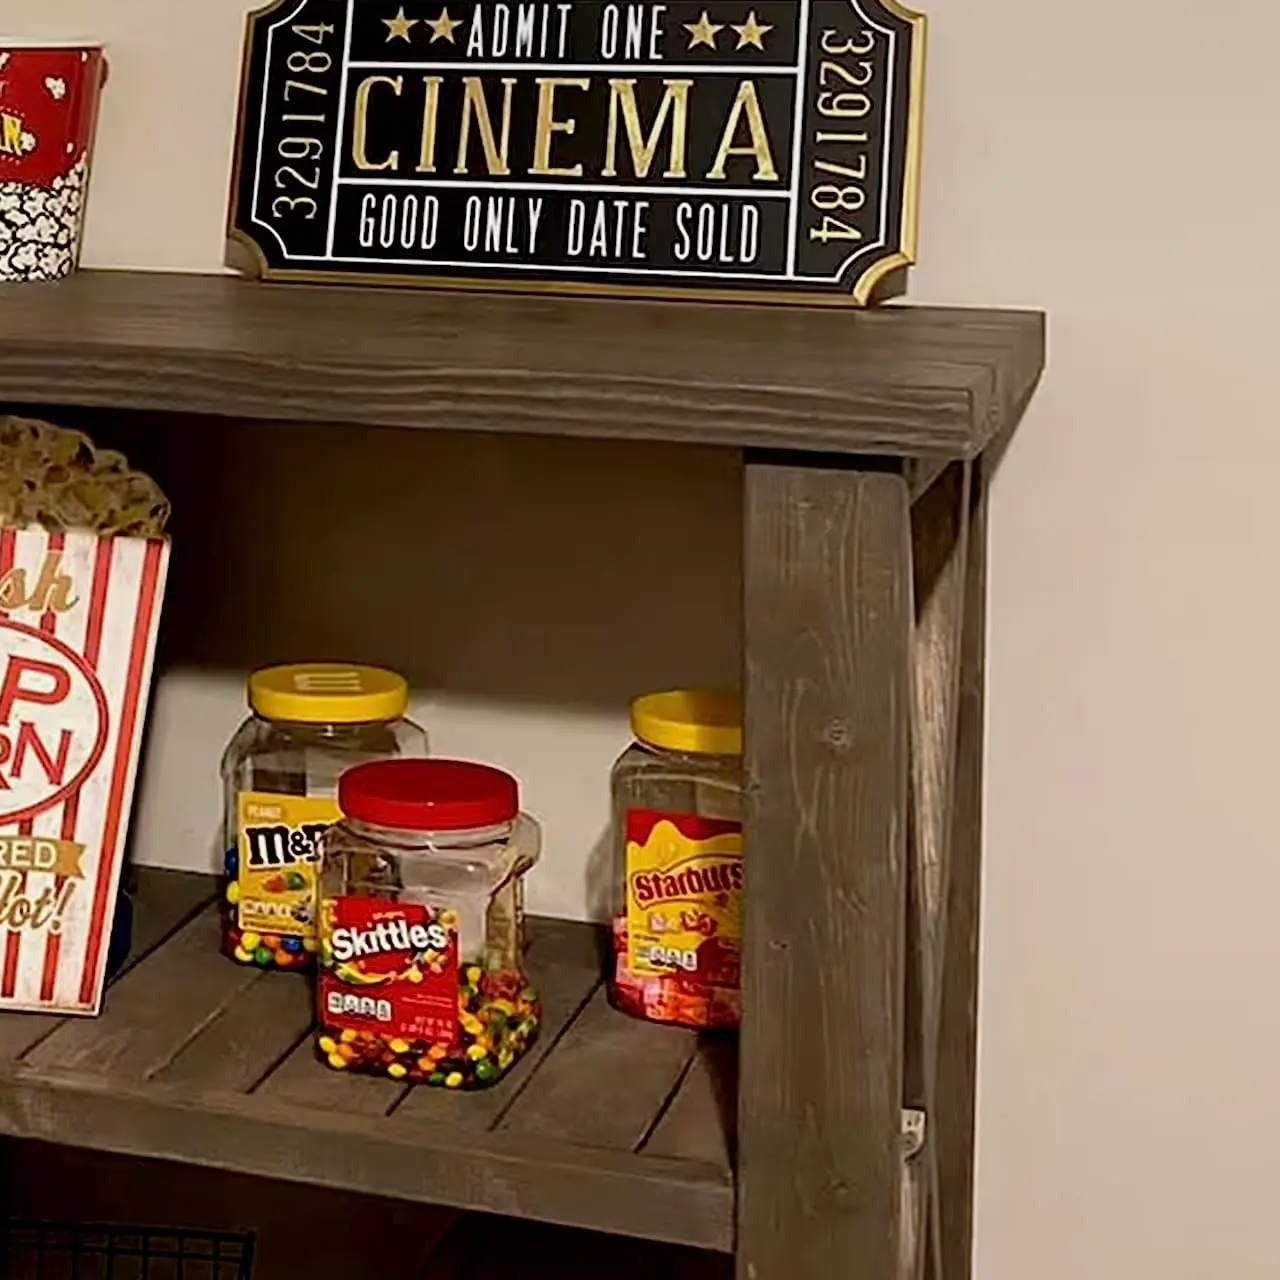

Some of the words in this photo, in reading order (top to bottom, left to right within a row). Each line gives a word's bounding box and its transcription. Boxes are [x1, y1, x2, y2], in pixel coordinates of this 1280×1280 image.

[466, 3, 573, 59] ADMIT
[600, 5, 667, 61] ONE
[272, 21, 335, 220] 3291784
[352, 75, 780, 183] CINEMA
[810, 29, 875, 245] 3291784
[359, 193, 439, 249] GOOD
[464, 196, 546, 256] ONLY
[568, 201, 650, 261] DATE
[674, 203, 760, 264] SOLD
[331, 919, 448, 961] Skittles
